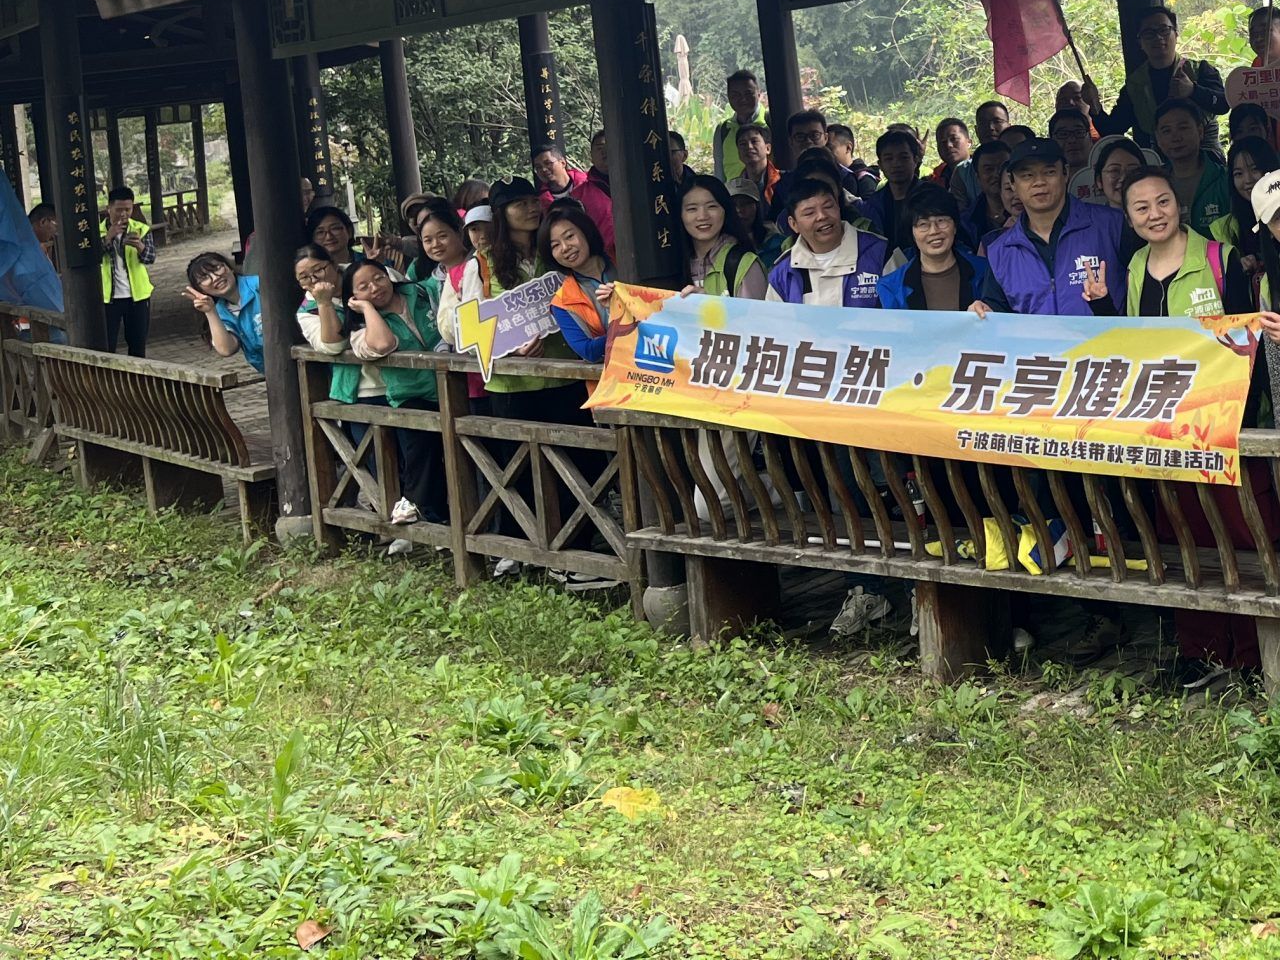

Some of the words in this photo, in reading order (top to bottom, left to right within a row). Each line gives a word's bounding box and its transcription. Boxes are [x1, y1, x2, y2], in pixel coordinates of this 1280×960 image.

[626, 371, 660, 385] NINGBO
[661, 377, 676, 388] MH
[957, 429, 1225, 472] 宁波萌恒花边&线带秋季团建活动
